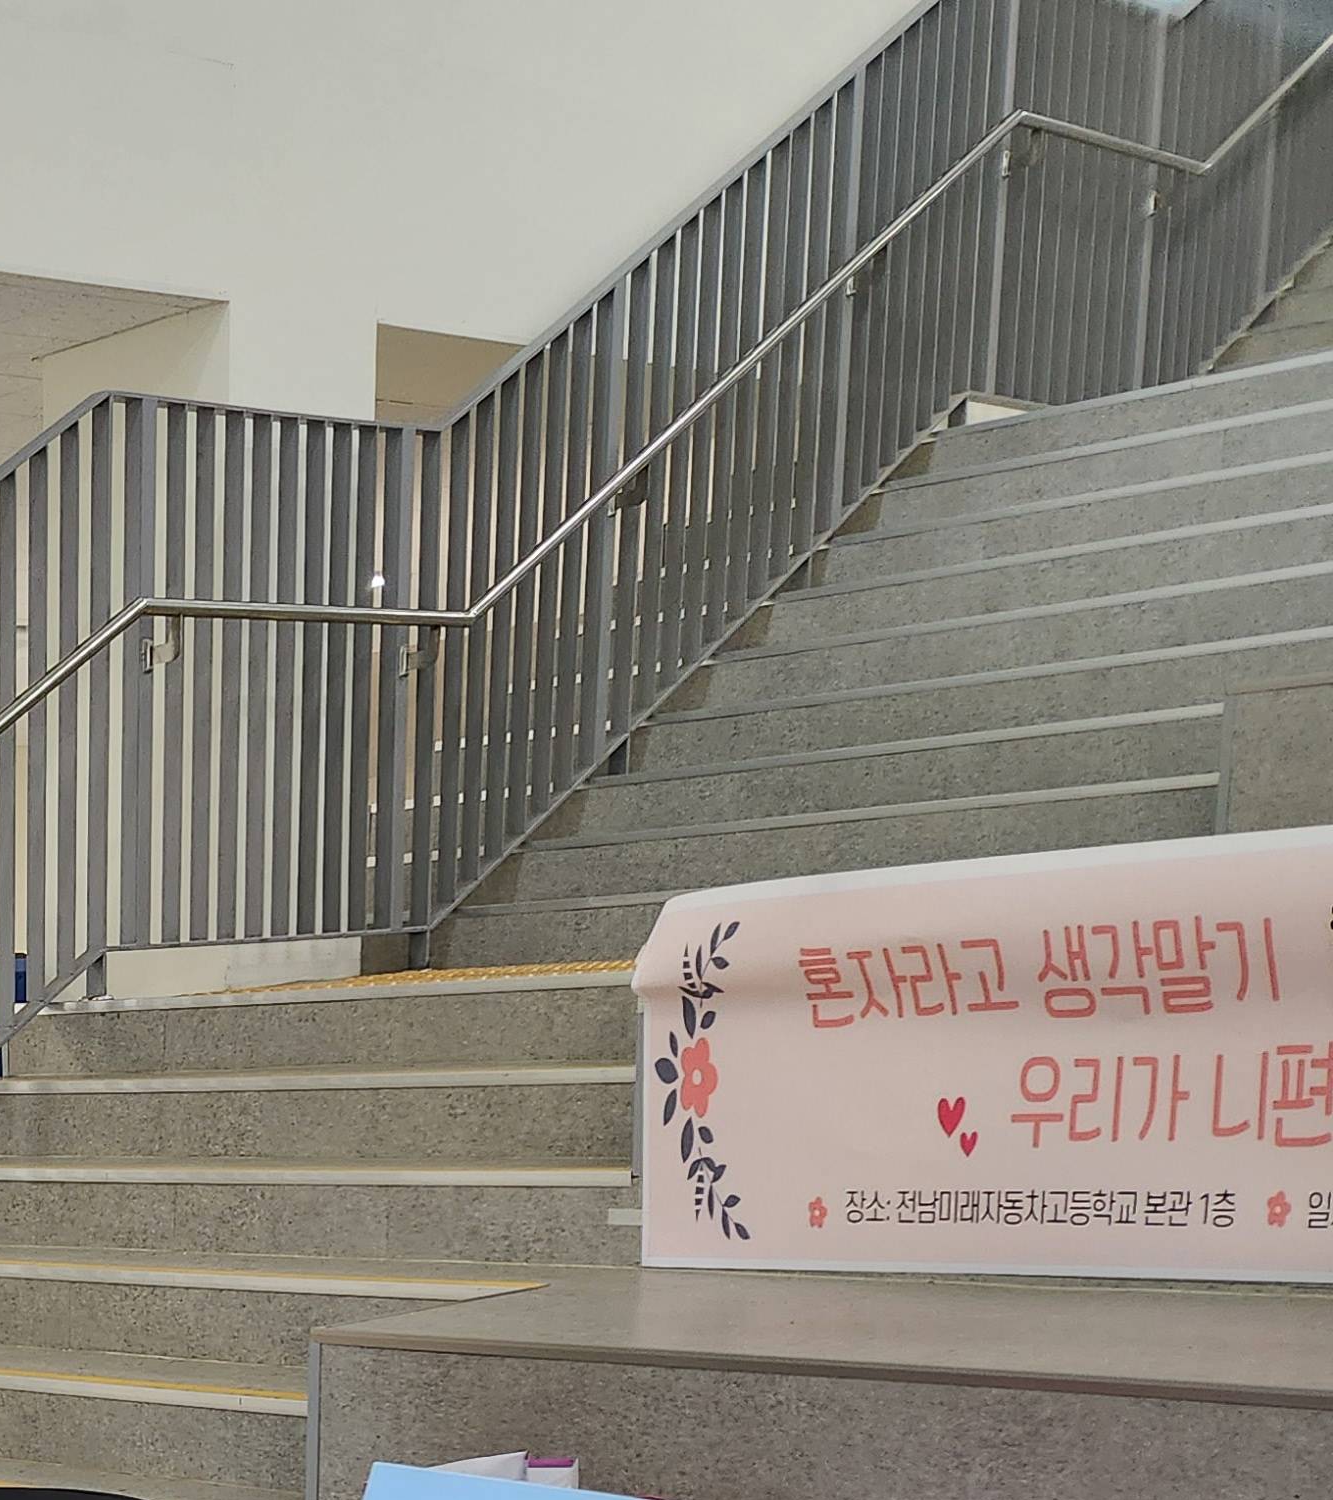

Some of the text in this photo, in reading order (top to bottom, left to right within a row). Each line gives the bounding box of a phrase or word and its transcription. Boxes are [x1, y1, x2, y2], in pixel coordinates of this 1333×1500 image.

[798, 915, 1280, 1029] 혼자라고 생각말기
[1010, 1054, 1191, 1149] 우리가
[844, 1188, 1237, 1228] 장소: 전남미래자동차고등학교 본관 1층
[1307, 1190, 1333, 1230] 일
